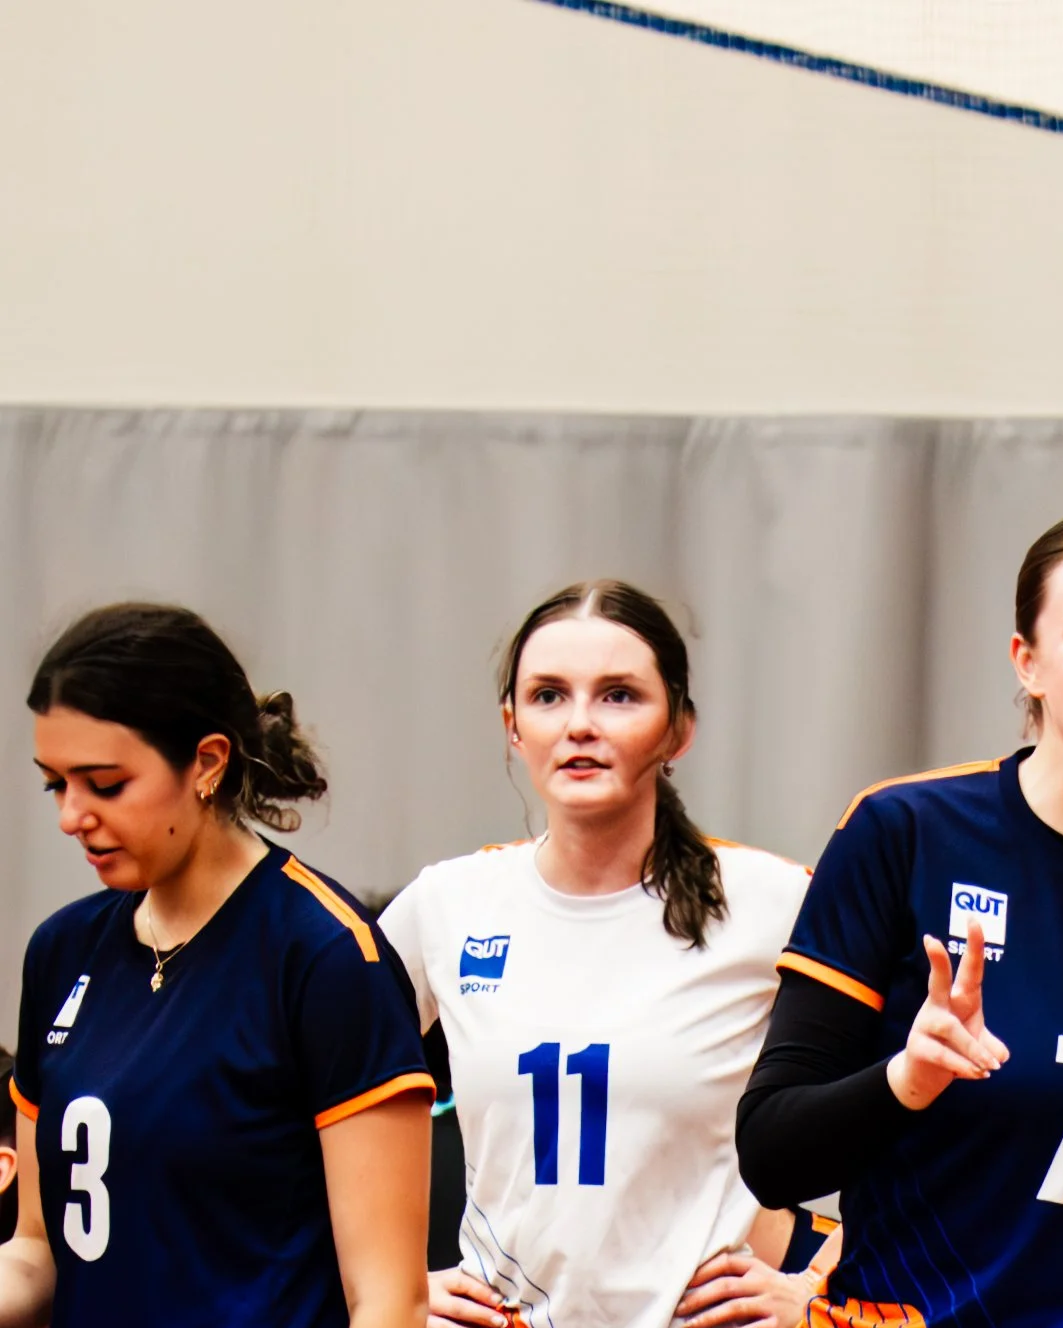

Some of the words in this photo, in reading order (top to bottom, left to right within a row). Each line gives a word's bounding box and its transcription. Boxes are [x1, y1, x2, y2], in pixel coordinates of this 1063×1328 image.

[955, 892, 1004, 916] QUT
[464, 938, 509, 959] QUT
[947, 940, 1004, 962] SPRT
[460, 982, 500, 995] SPORT
[518, 1042, 610, 1185] 11
[61, 1095, 112, 1262] 3
